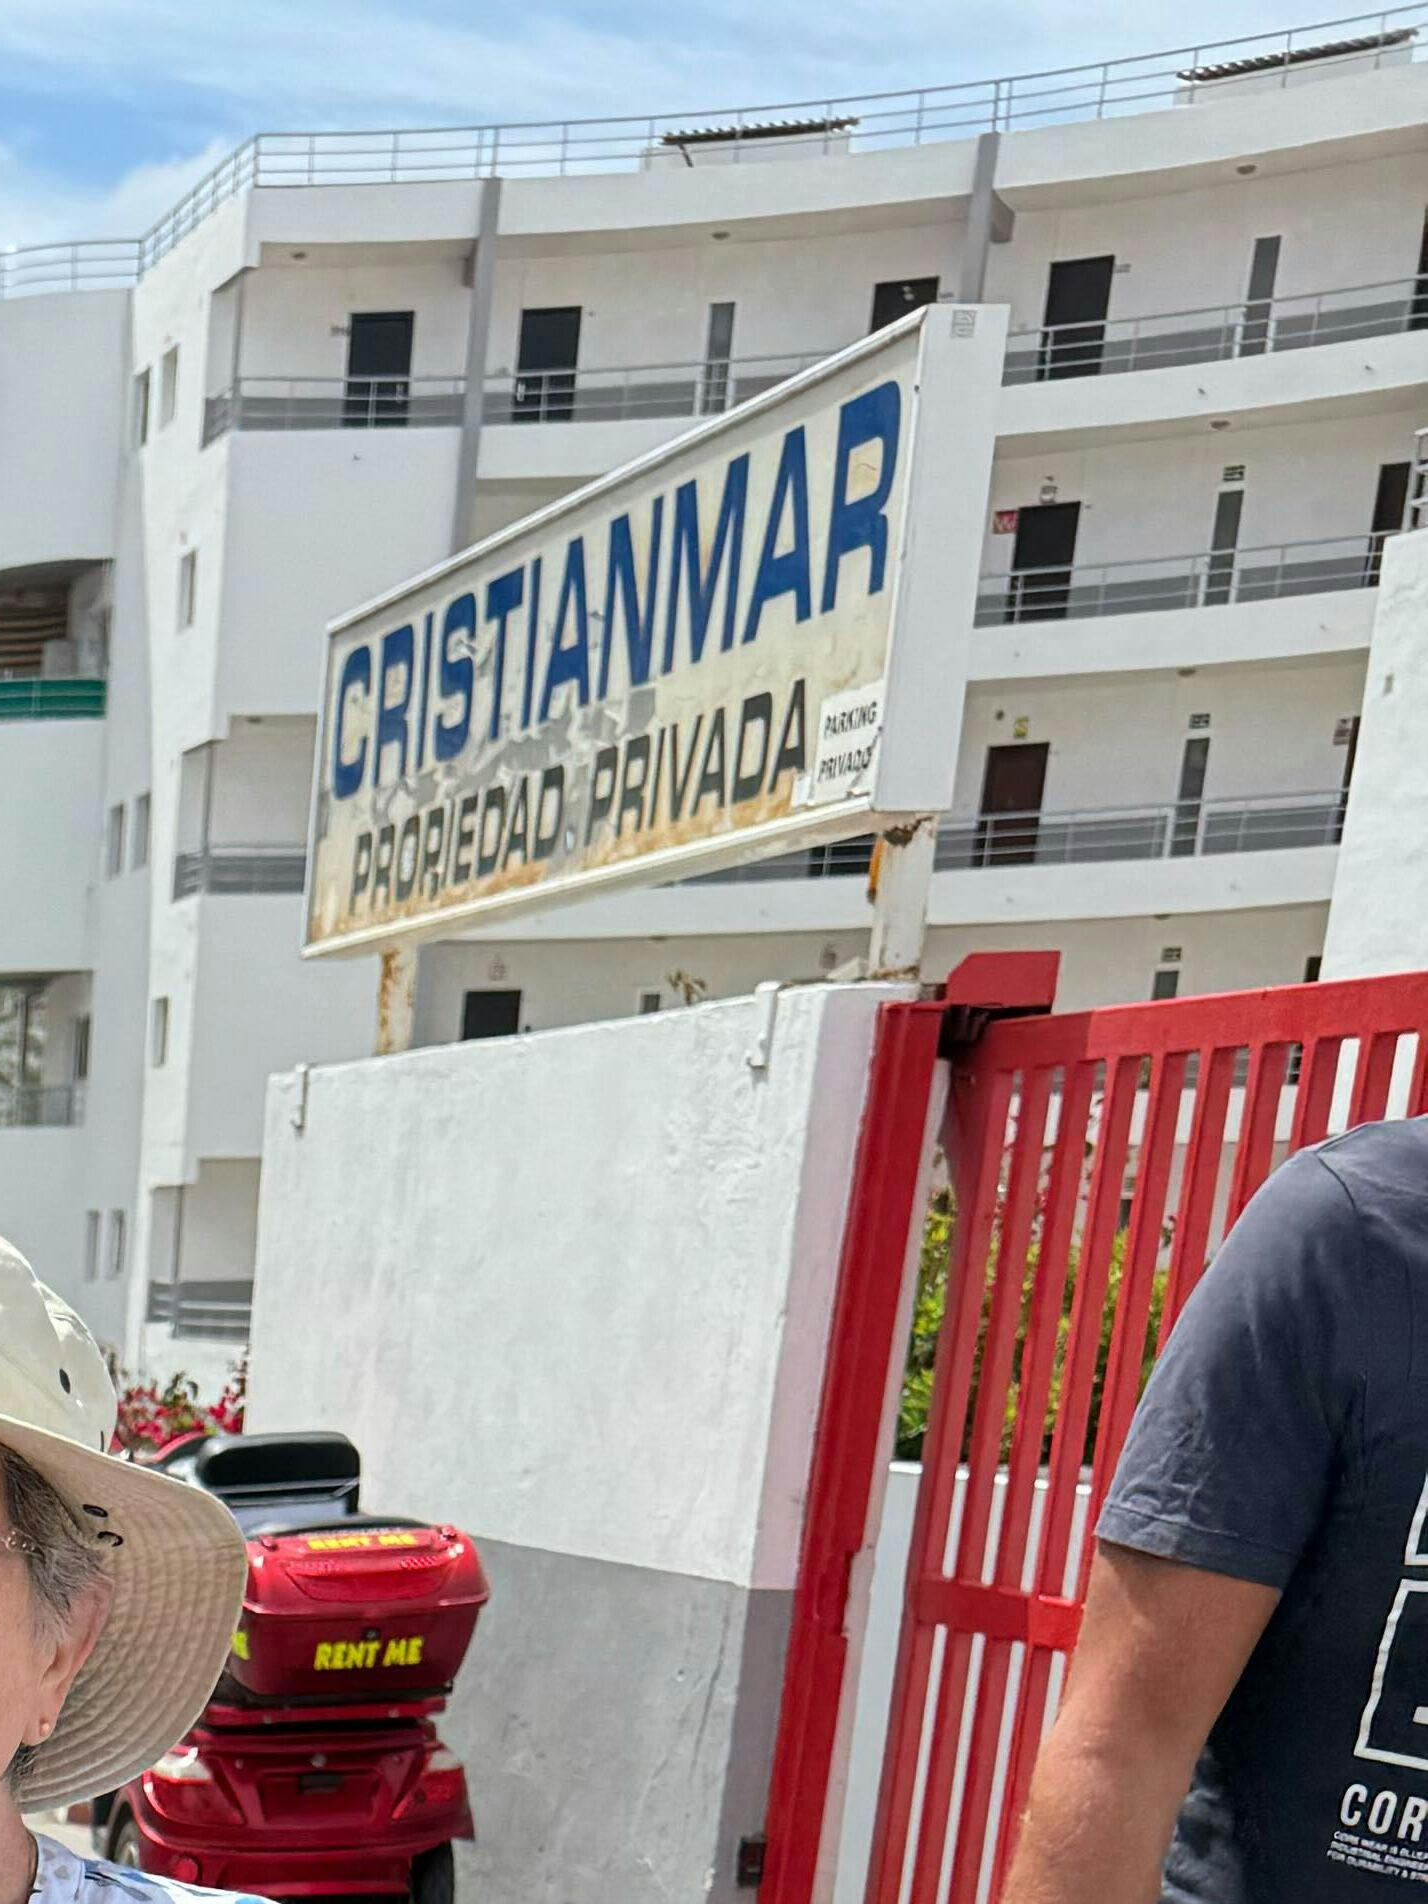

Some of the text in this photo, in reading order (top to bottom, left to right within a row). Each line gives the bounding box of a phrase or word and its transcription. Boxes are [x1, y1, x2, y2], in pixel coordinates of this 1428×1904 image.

[330, 380, 901, 801] CRISTIANMAR
[825, 701, 877, 738] PARKING
[350, 679, 806, 914] PROPIEDAD PRIVADA
[314, 1636, 423, 1671] RENT ME
